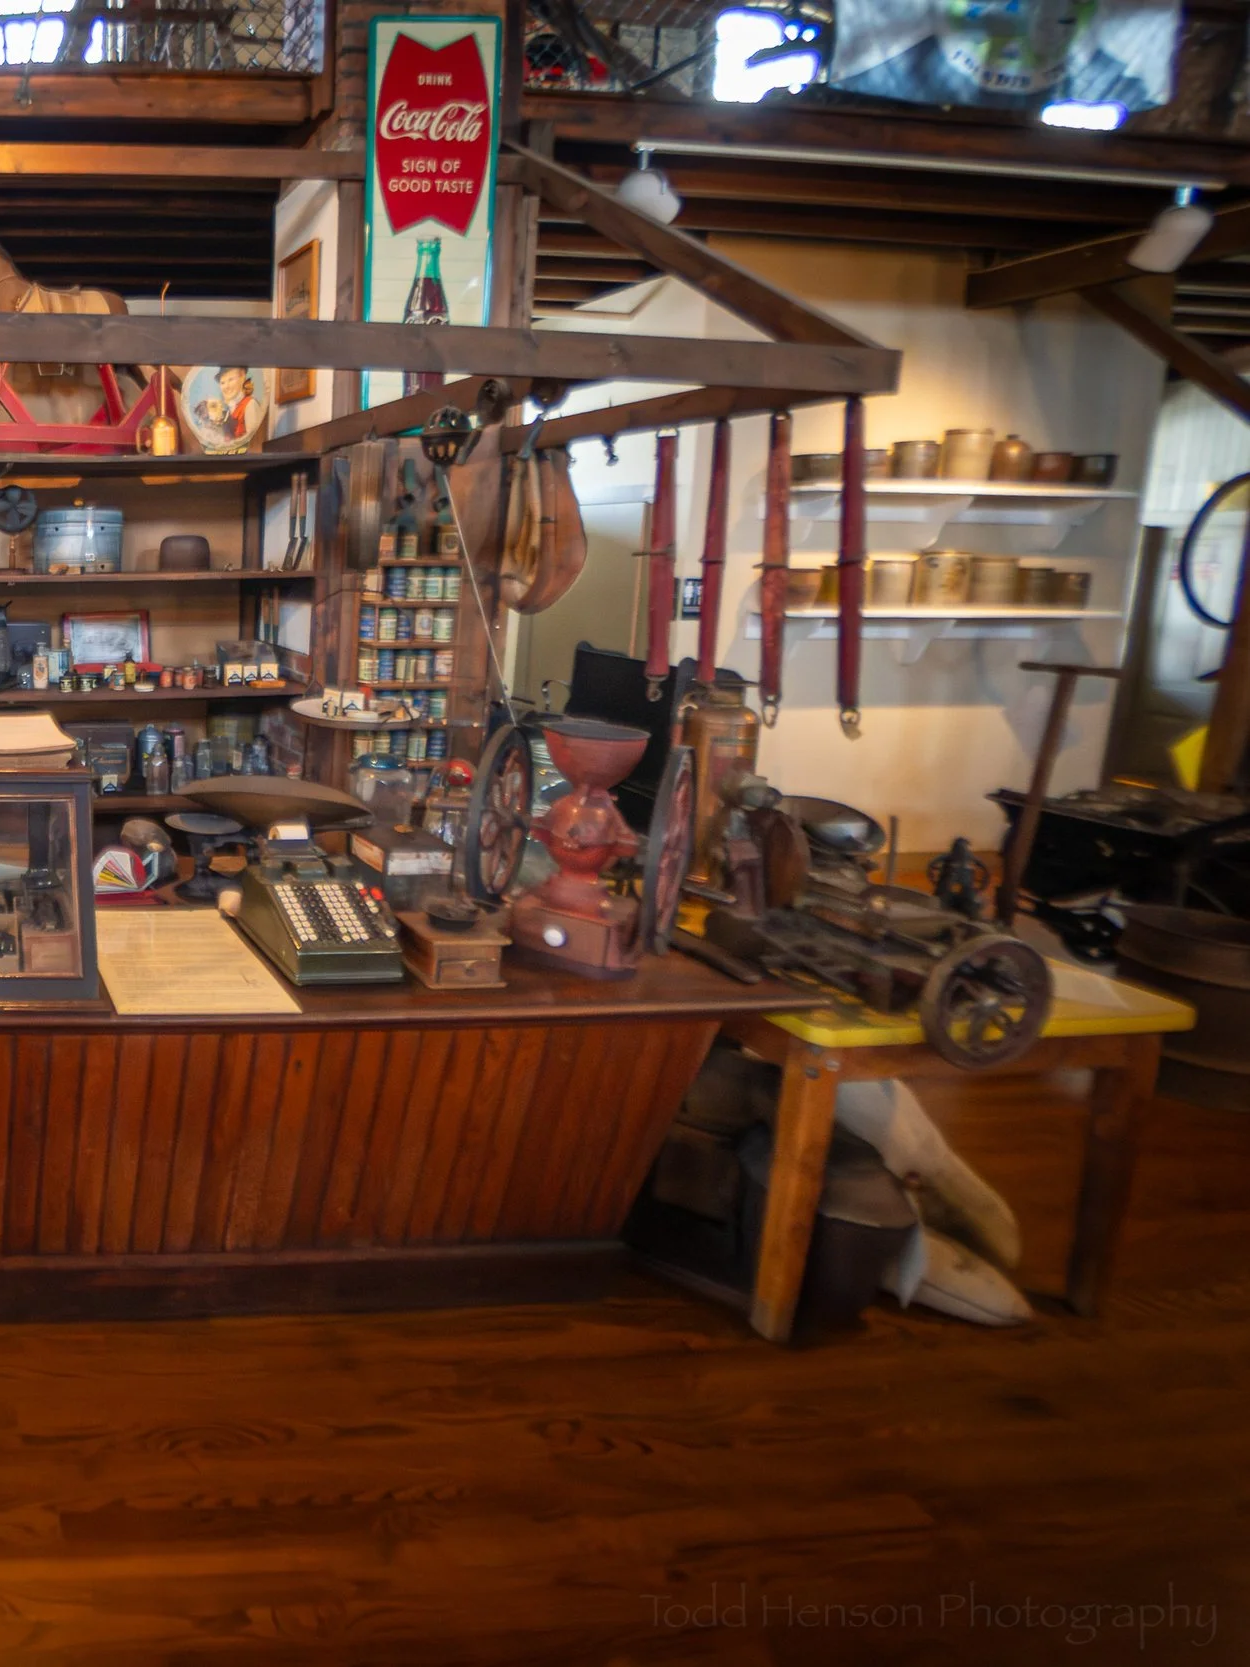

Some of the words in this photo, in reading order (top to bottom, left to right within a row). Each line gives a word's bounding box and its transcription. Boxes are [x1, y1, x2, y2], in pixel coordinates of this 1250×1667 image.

[418, 73, 453, 86] DRINK
[380, 100, 488, 142] Coca-Cola
[402, 160, 437, 174] SIGN
[441, 160, 461, 174] OF
[388, 179, 431, 193] GOOD
[434, 180, 474, 194] TASTE
